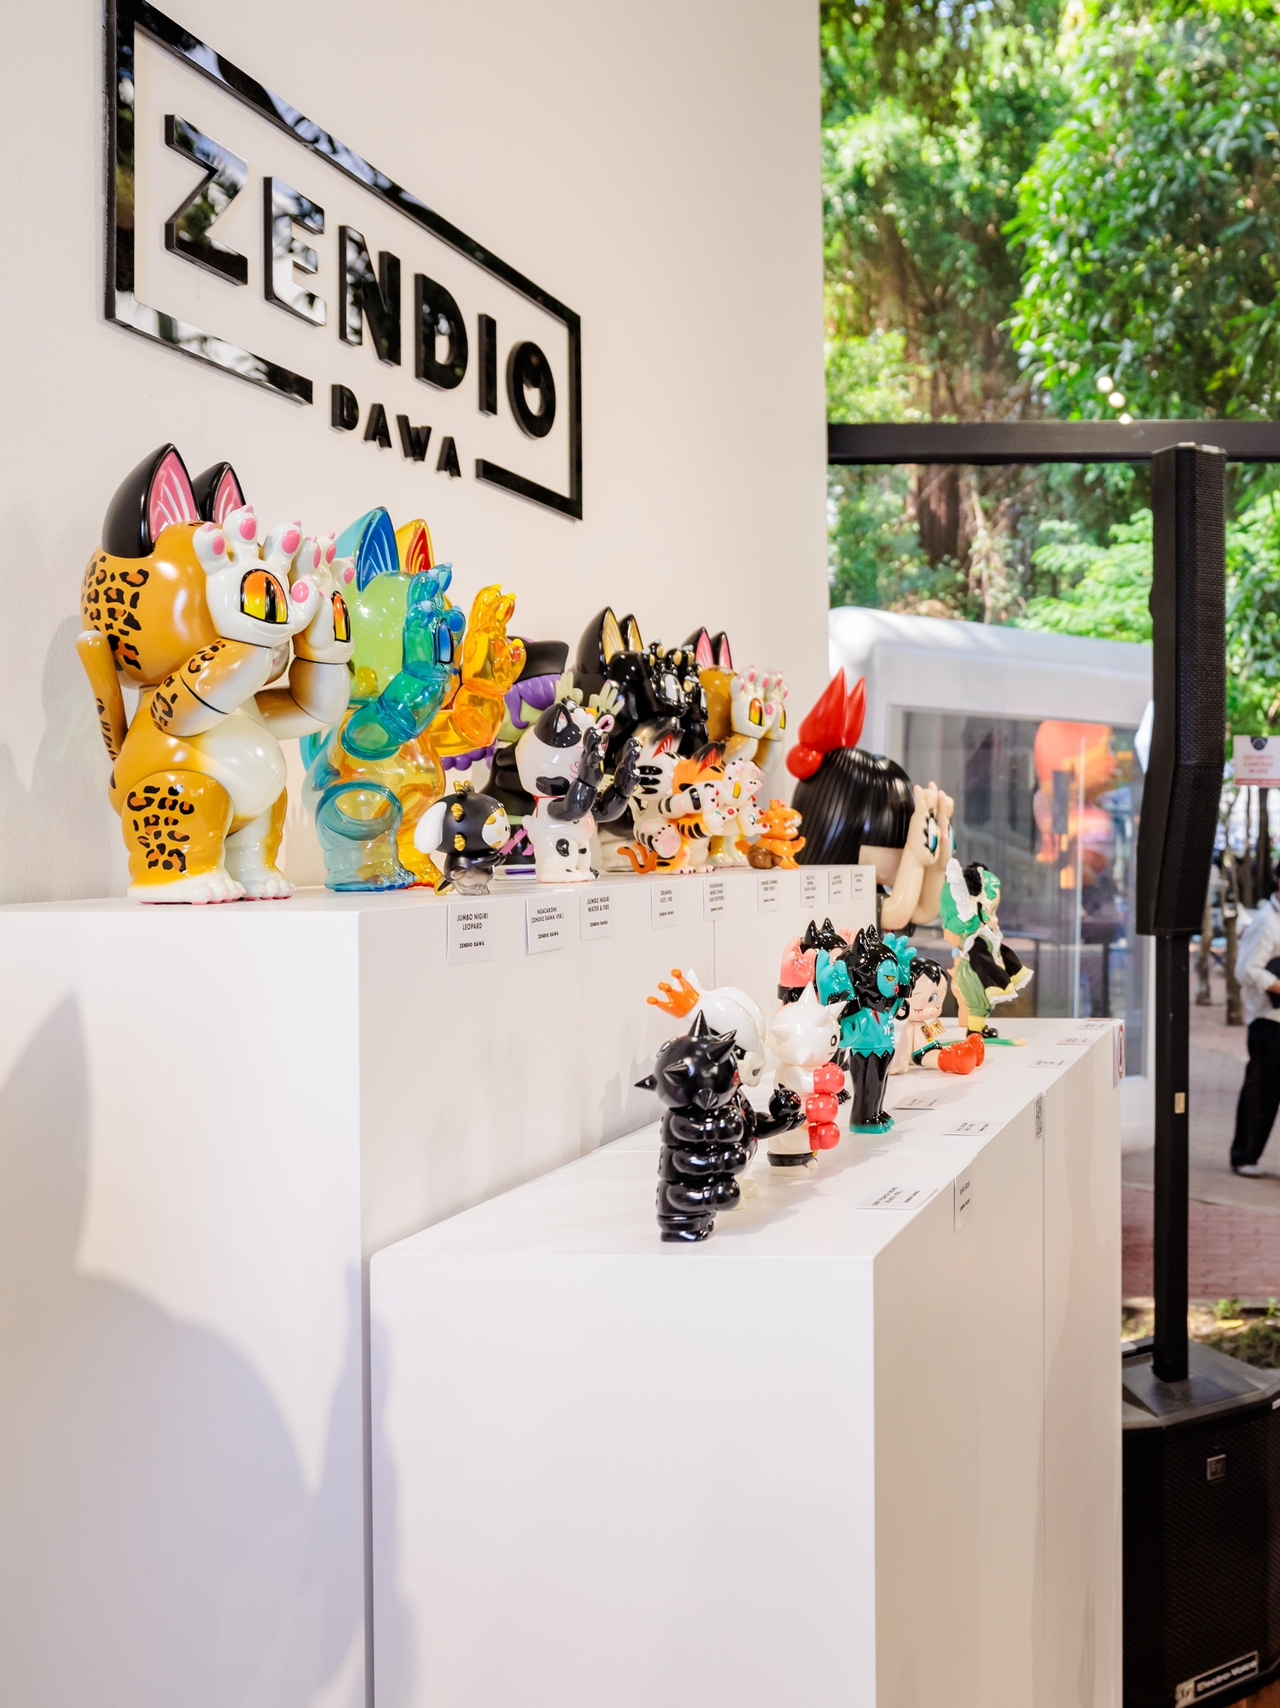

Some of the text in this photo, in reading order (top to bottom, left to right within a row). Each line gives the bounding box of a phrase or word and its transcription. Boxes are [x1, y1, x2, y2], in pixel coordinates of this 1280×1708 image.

[163, 113, 557, 440] ZENDIO
[331, 383, 462, 478] DAWA
[587, 897, 599, 905] JUMBO
[457, 912, 489, 922] JUMBO NIGIRI
[462, 922, 483, 931] LEOPARD
